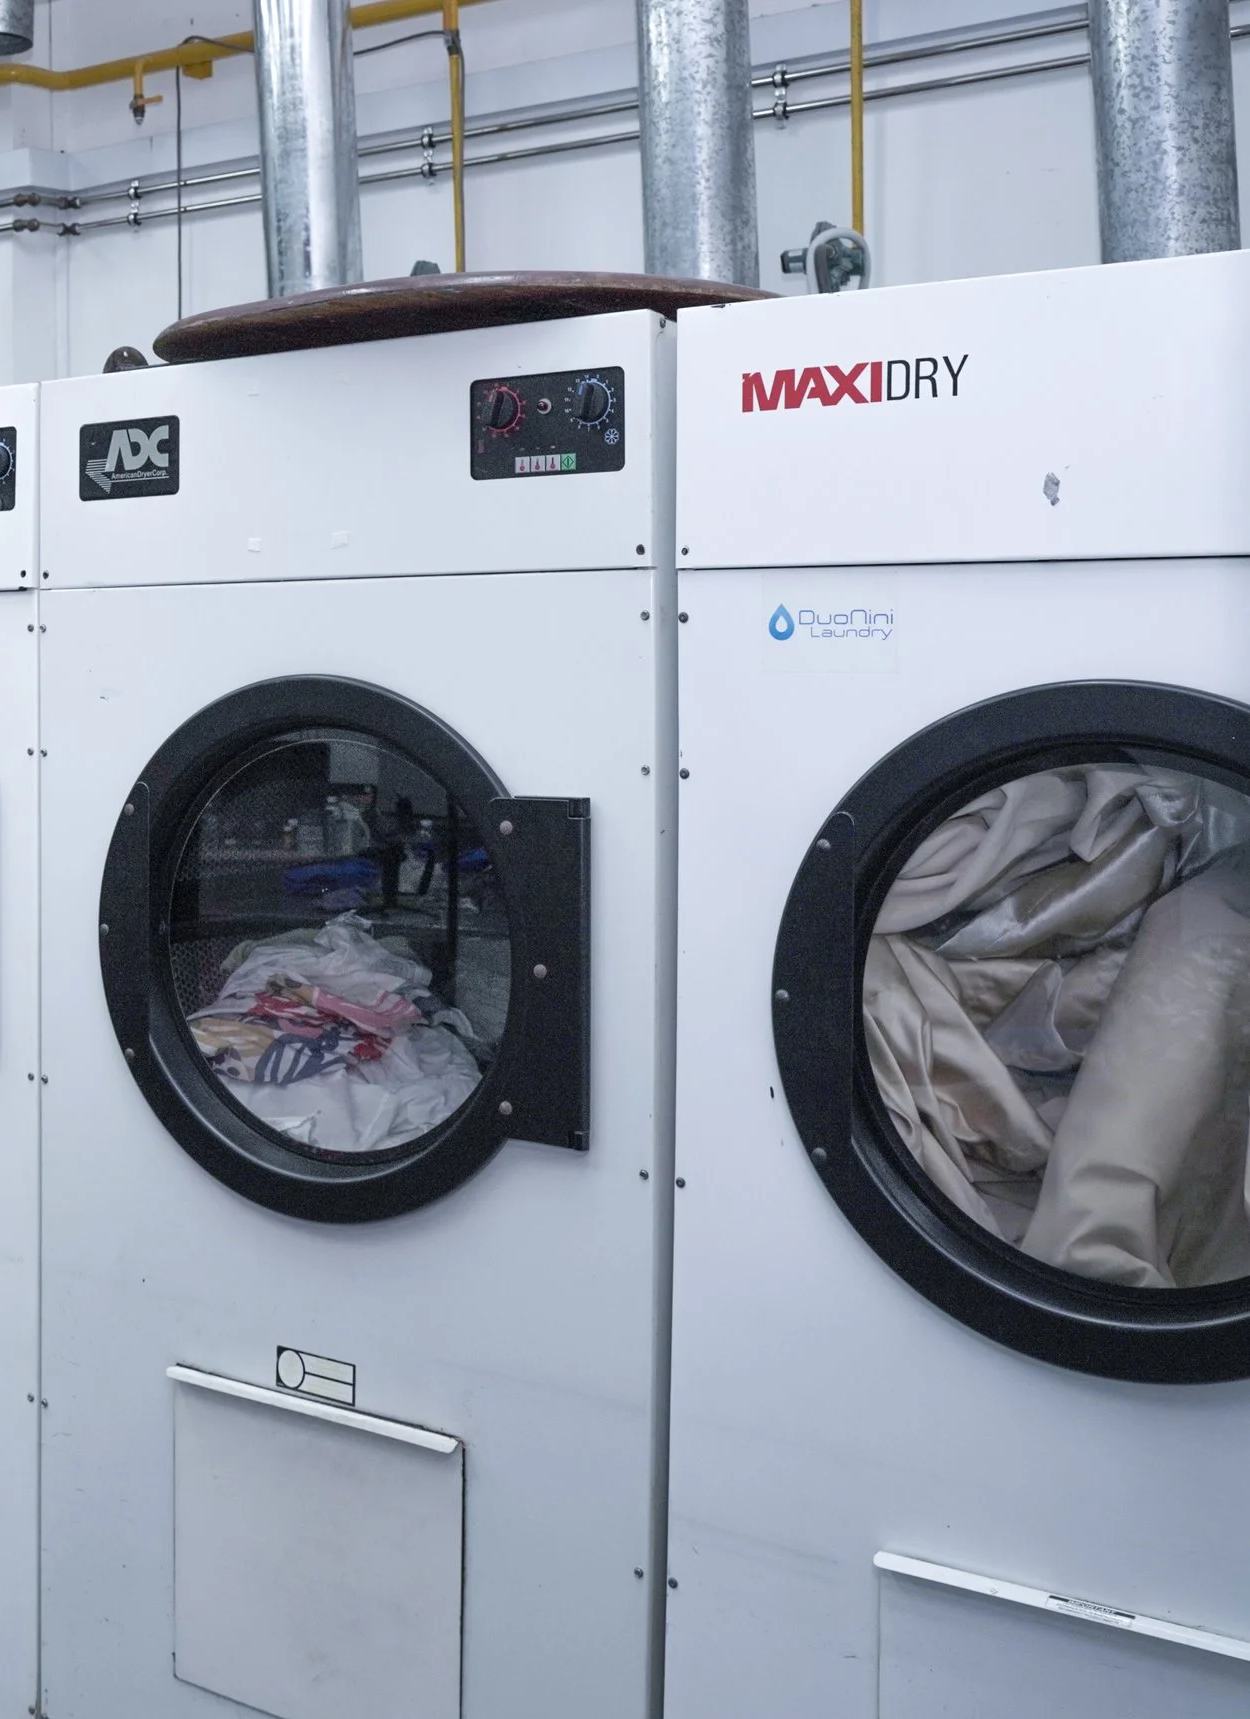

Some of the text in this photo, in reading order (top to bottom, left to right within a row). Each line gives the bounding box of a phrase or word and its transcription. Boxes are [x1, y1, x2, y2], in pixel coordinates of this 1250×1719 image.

[742, 354, 969, 413] MAXIDRY
[105, 425, 169, 472] ADC
[798, 608, 894, 625] DuoNini
[810, 626, 893, 641] Laundry
